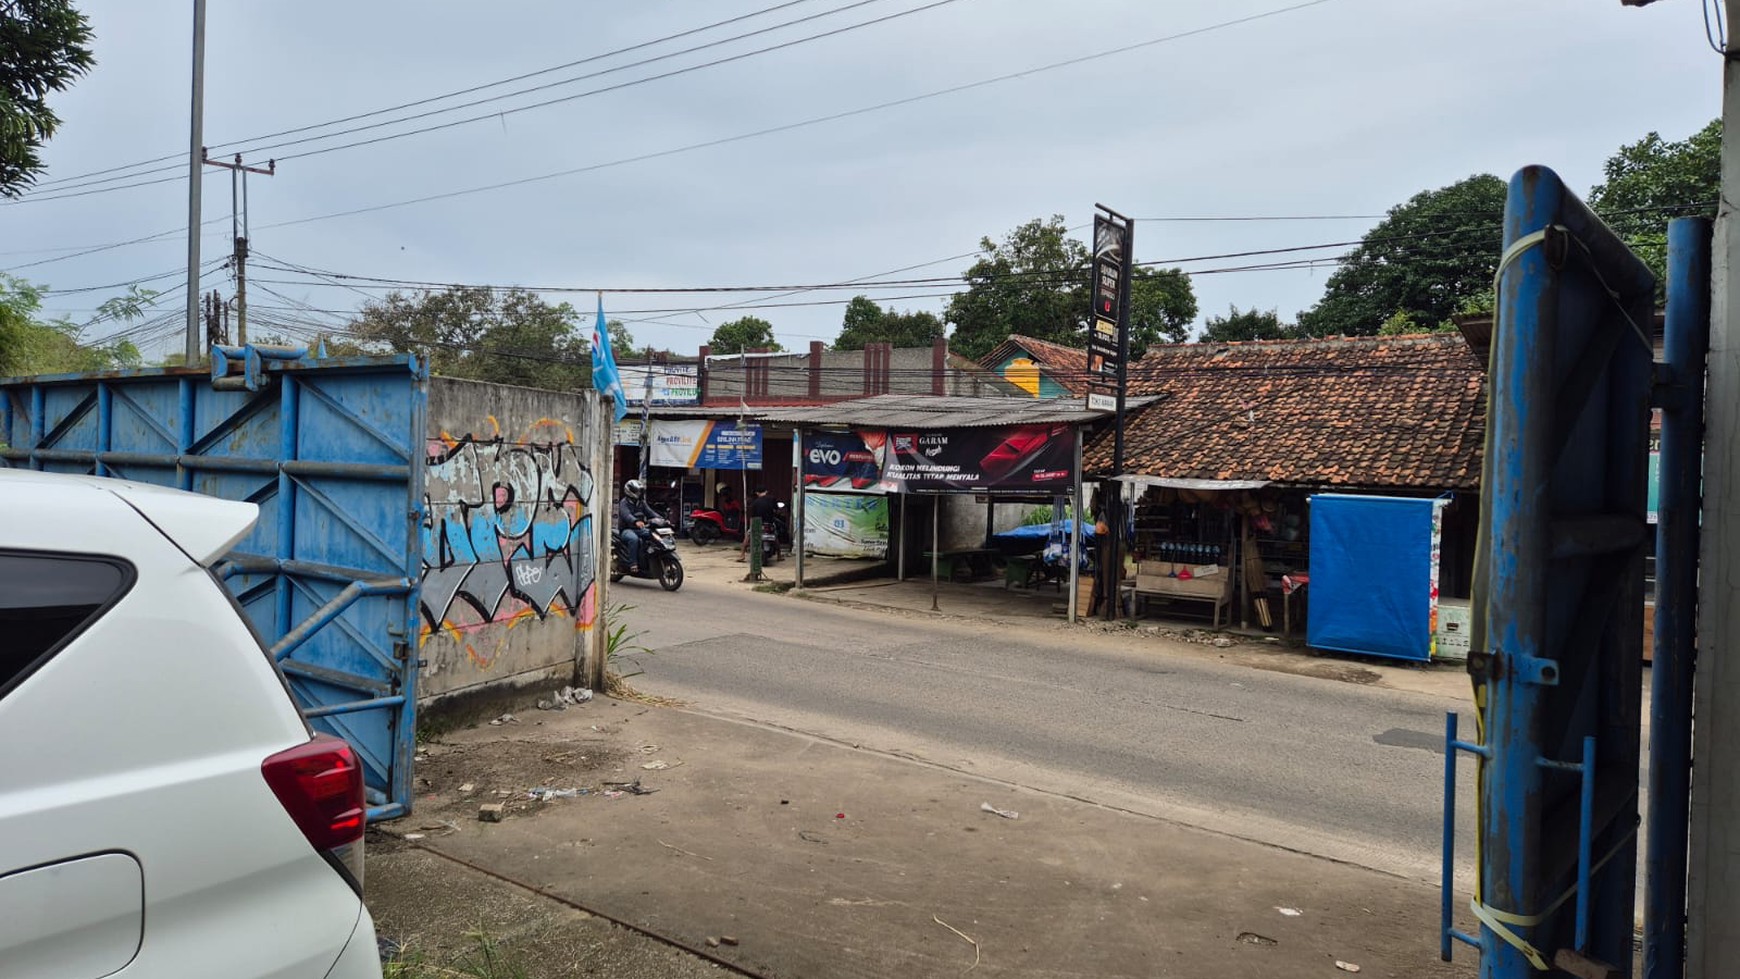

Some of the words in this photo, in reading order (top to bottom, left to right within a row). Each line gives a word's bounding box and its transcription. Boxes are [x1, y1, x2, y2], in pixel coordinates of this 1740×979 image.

[918, 436, 949, 445] GARAM
[809, 448, 842, 466] evo
[916, 464, 961, 473] MELINDUNGI
[886, 471, 922, 480] KUALITAS
[922, 472, 945, 480] TETAP
[944, 473, 980, 482] MENYALA
